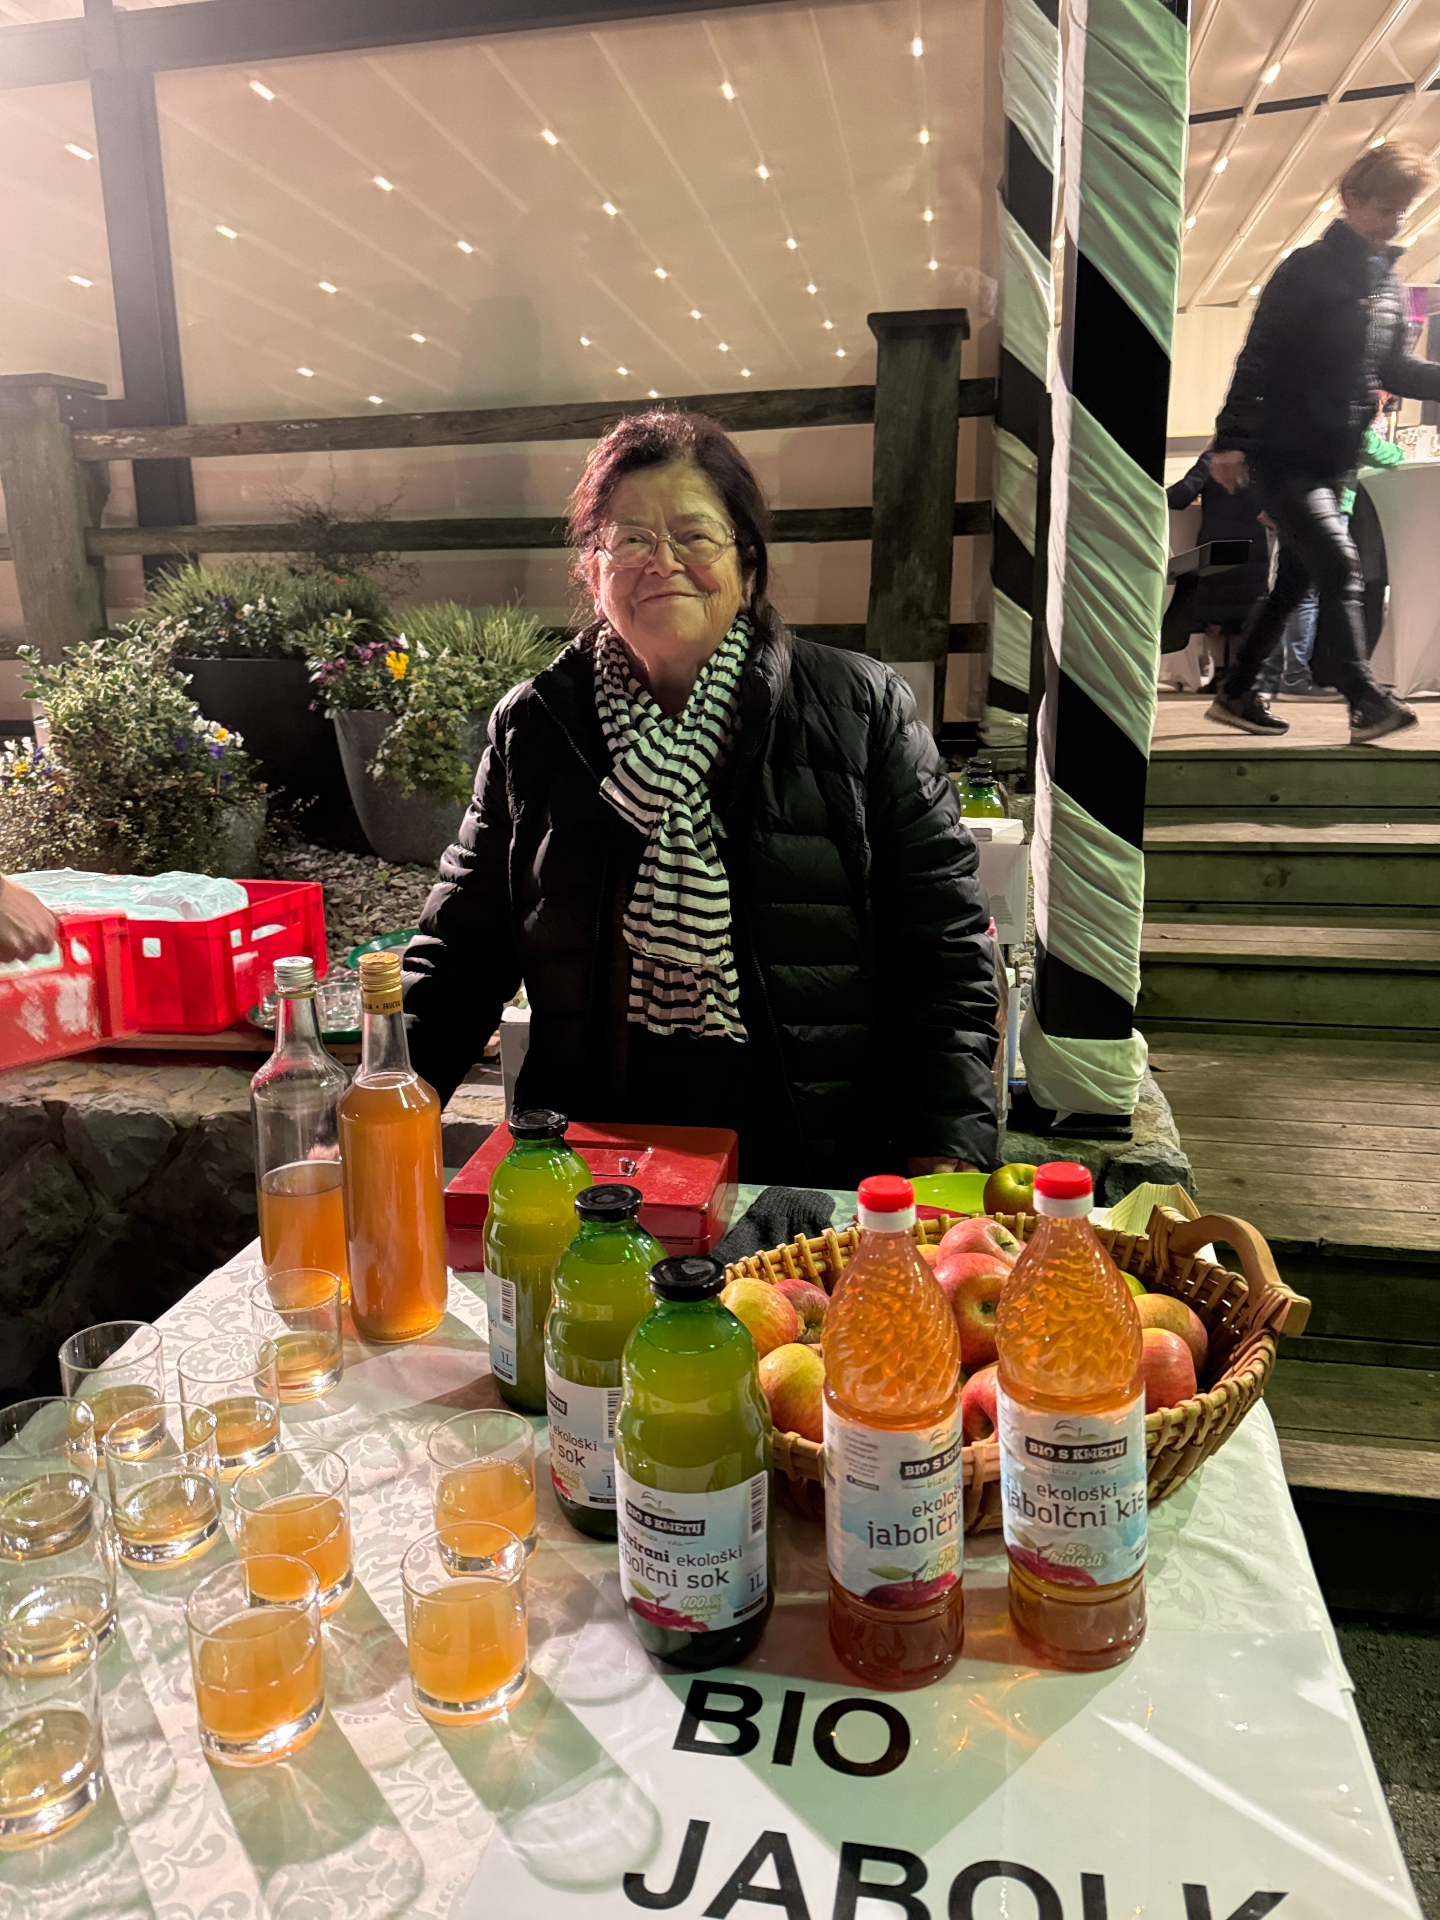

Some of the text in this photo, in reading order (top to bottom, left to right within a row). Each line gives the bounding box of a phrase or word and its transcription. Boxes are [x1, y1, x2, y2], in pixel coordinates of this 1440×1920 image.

[553, 1425, 598, 1452] ekološki
[558, 1444, 586, 1469] sok
[1028, 1441, 1125, 1460] BIO S KMETIJ
[905, 1458, 942, 1477] BIO S
[1036, 1482, 1118, 1502] ekološki
[627, 1503, 702, 1535] BIO S KMETIJ
[619, 1541, 730, 1589] abolčni sok
[677, 1545, 743, 1567] ekološki
[750, 1573, 764, 1593] 1L
[672, 1679, 912, 1778] BIO
